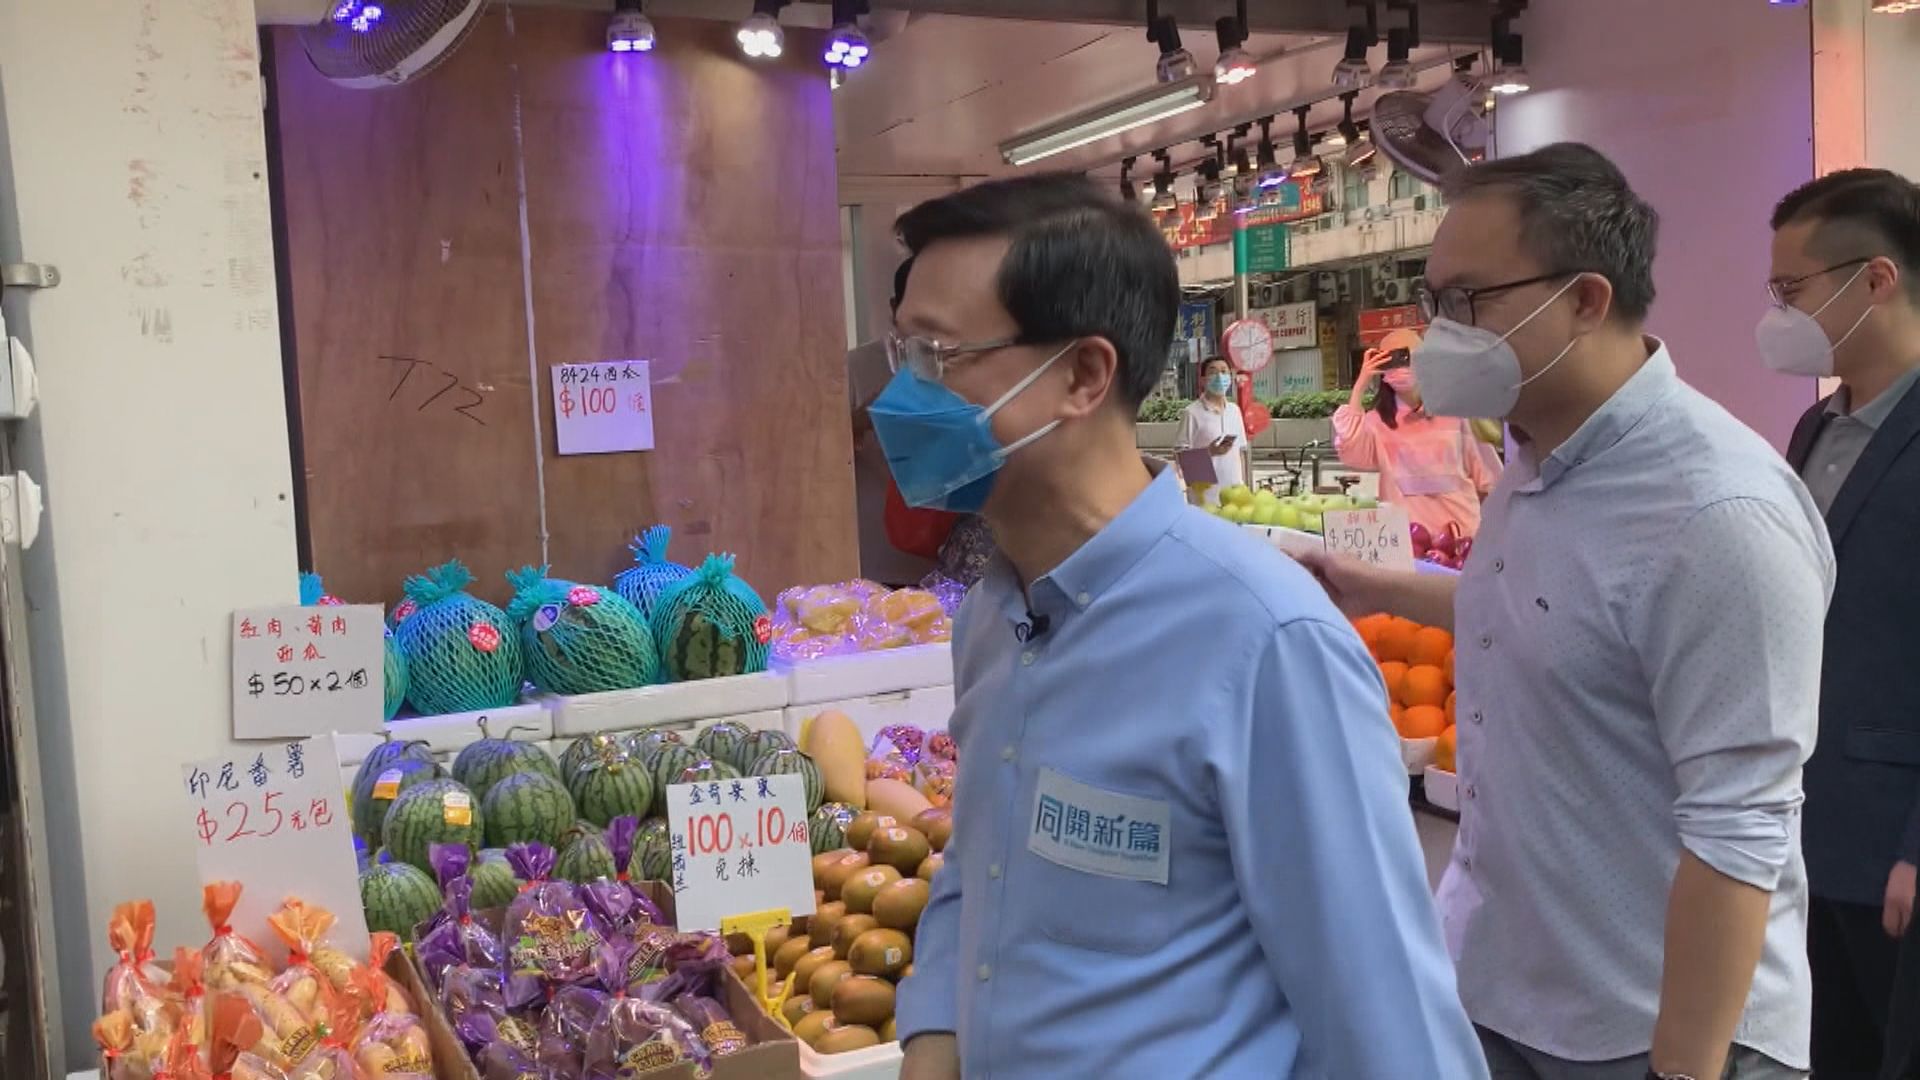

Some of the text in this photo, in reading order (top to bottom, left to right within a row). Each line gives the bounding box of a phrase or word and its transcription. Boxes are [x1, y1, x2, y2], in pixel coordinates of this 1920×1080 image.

[559, 384, 616, 419] $100
[276, 642, 326, 663] 西瓜
[188, 742, 305, 799] 印尼番薯
[1035, 793, 1162, 853] 同開新篇
